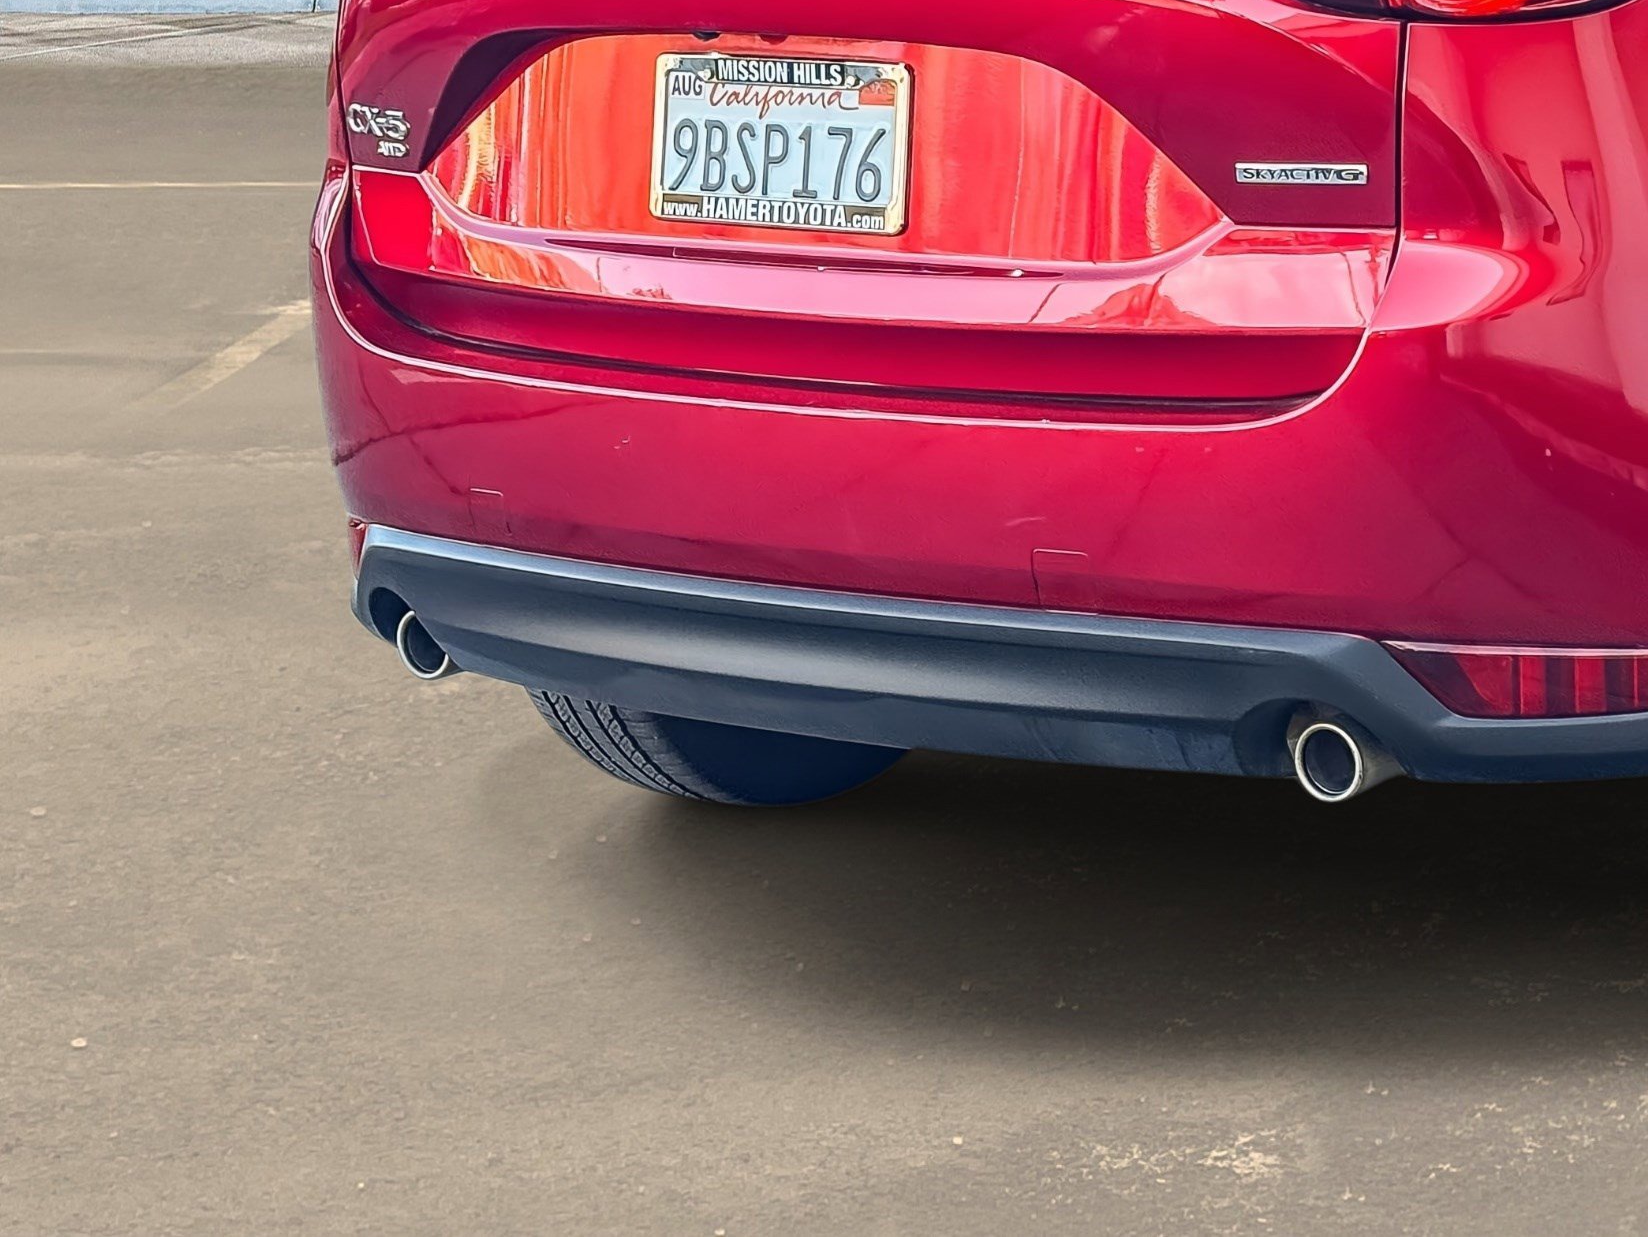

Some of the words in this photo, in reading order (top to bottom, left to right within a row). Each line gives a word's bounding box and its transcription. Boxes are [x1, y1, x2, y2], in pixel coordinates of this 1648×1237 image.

[671, 74, 703, 97] AUG
[717, 59, 788, 83] MISSION
[792, 63, 842, 87] HILLS
[708, 81, 859, 120] California
[347, 103, 411, 140] CX-5
[668, 117, 887, 203] 9BSP176
[663, 196, 885, 230] www.HAMERTOYOTA.com
